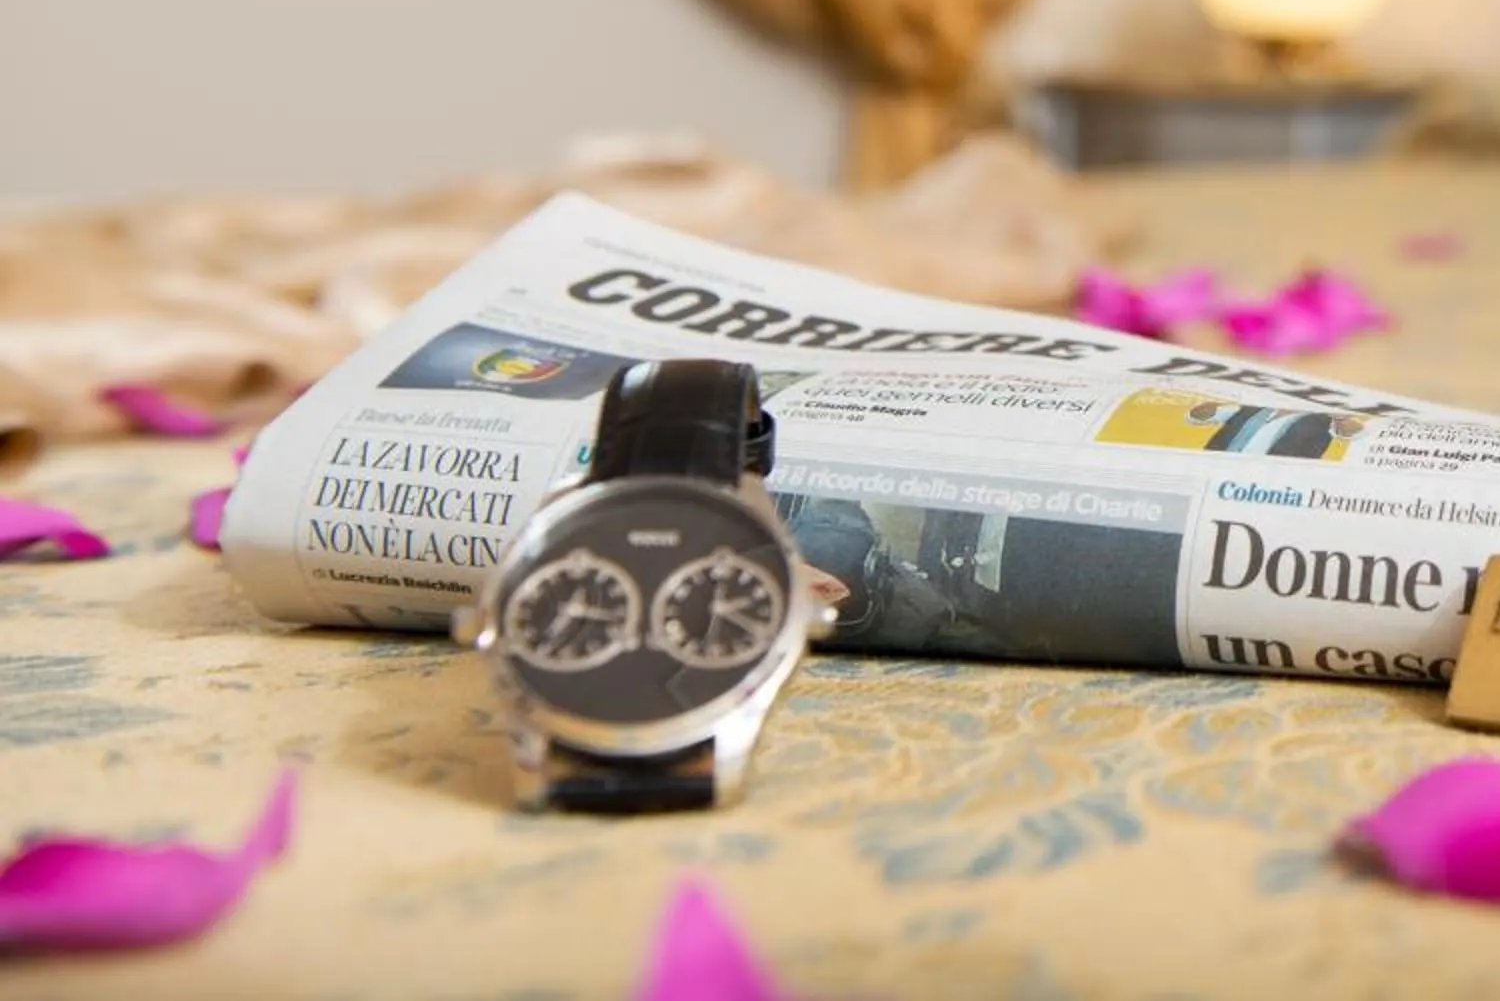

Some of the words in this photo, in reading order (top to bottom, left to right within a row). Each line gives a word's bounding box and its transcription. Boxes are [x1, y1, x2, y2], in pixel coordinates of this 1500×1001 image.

[567, 269, 1118, 360] CORRIERE
[991, 394, 1097, 413] diversi
[330, 437, 370, 469] LA
[371, 440, 521, 483] ZAVORRA
[1432, 448, 1479, 463] Luigi
[314, 475, 372, 513] DEI
[368, 480, 515, 527] MERCATI
[808, 467, 895, 496] ricordo
[898, 476, 960, 502] della
[961, 485, 1042, 515] strage
[1045, 489, 1072, 514] di
[1074, 491, 1164, 523] Charlie
[1217, 479, 1303, 509] Colonia
[1306, 488, 1404, 518] Denunce
[1405, 497, 1433, 520] da
[307, 517, 377, 556] NON
[402, 528, 444, 565] LA
[446, 532, 504, 569] CIN
[1202, 518, 1444, 613] Donne
[1201, 632, 1298, 670] un
